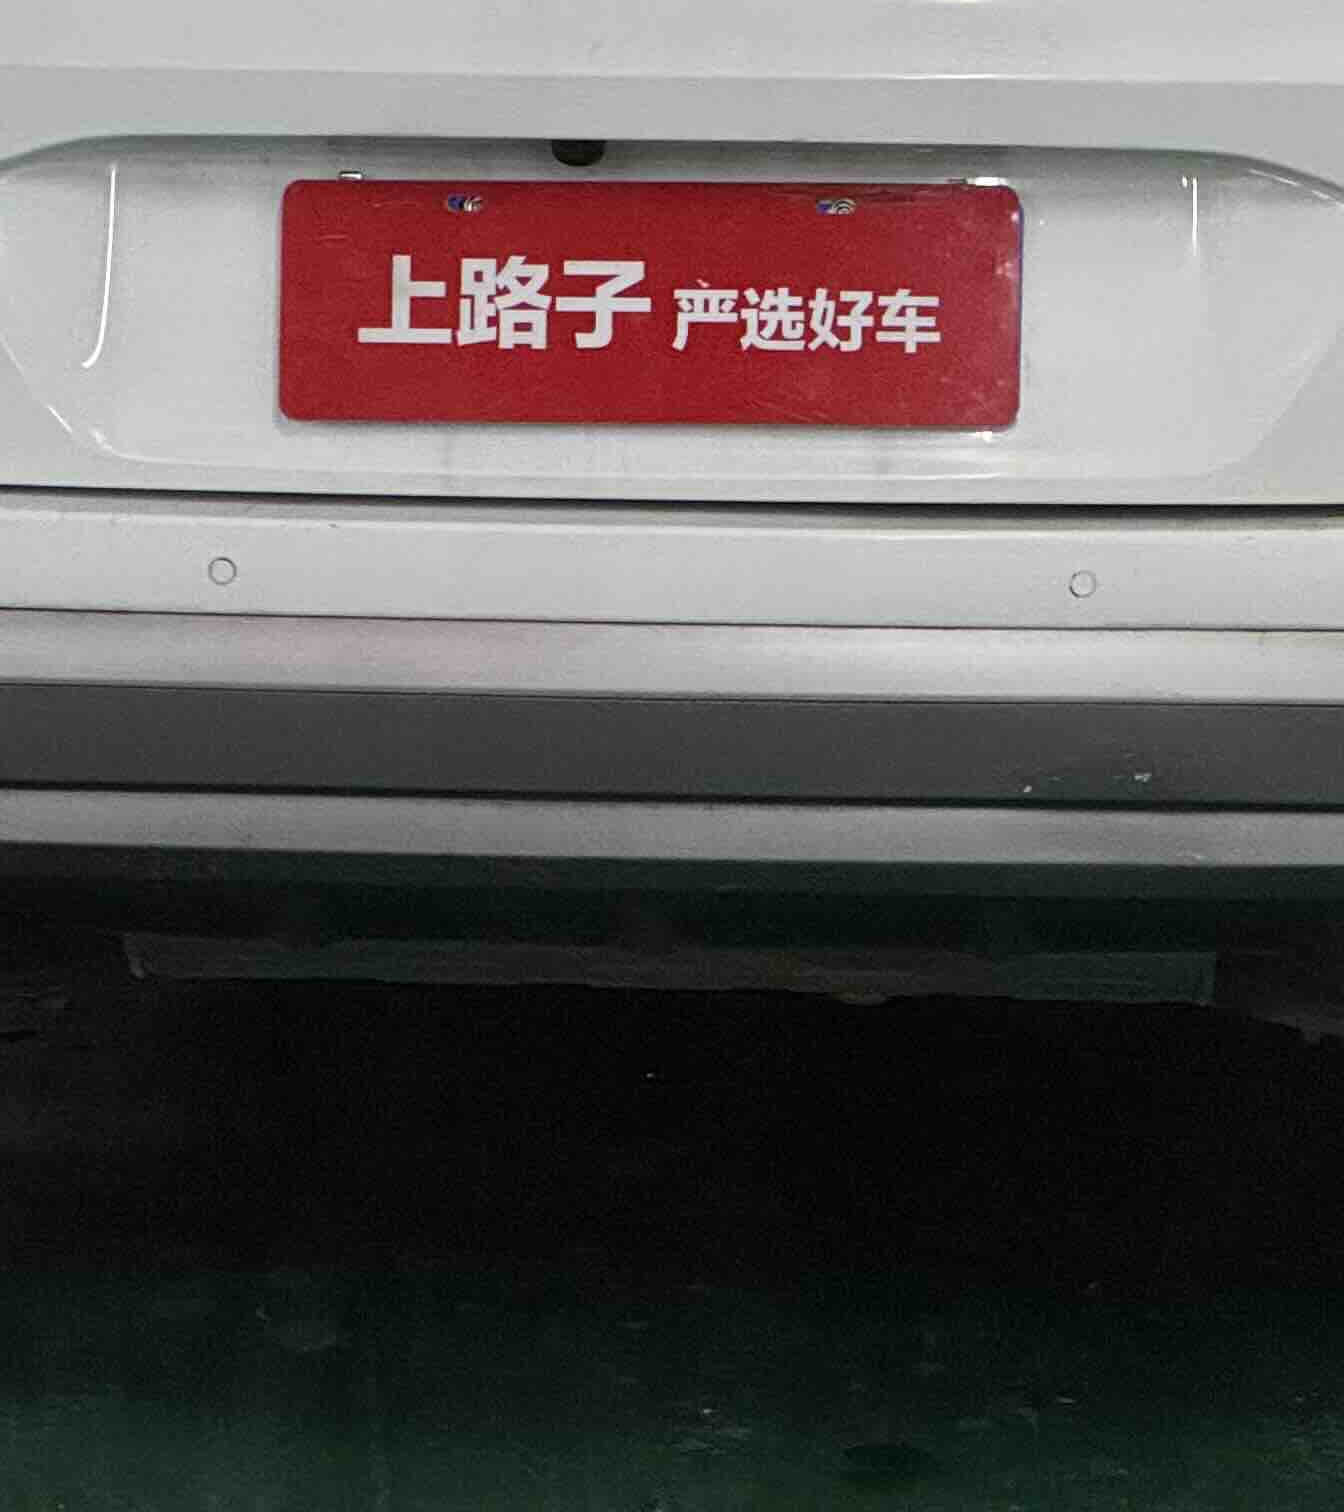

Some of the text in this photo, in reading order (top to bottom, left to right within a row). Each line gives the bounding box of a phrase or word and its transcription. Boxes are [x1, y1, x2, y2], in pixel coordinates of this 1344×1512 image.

[357, 254, 942, 354] 上路子 严选好车
